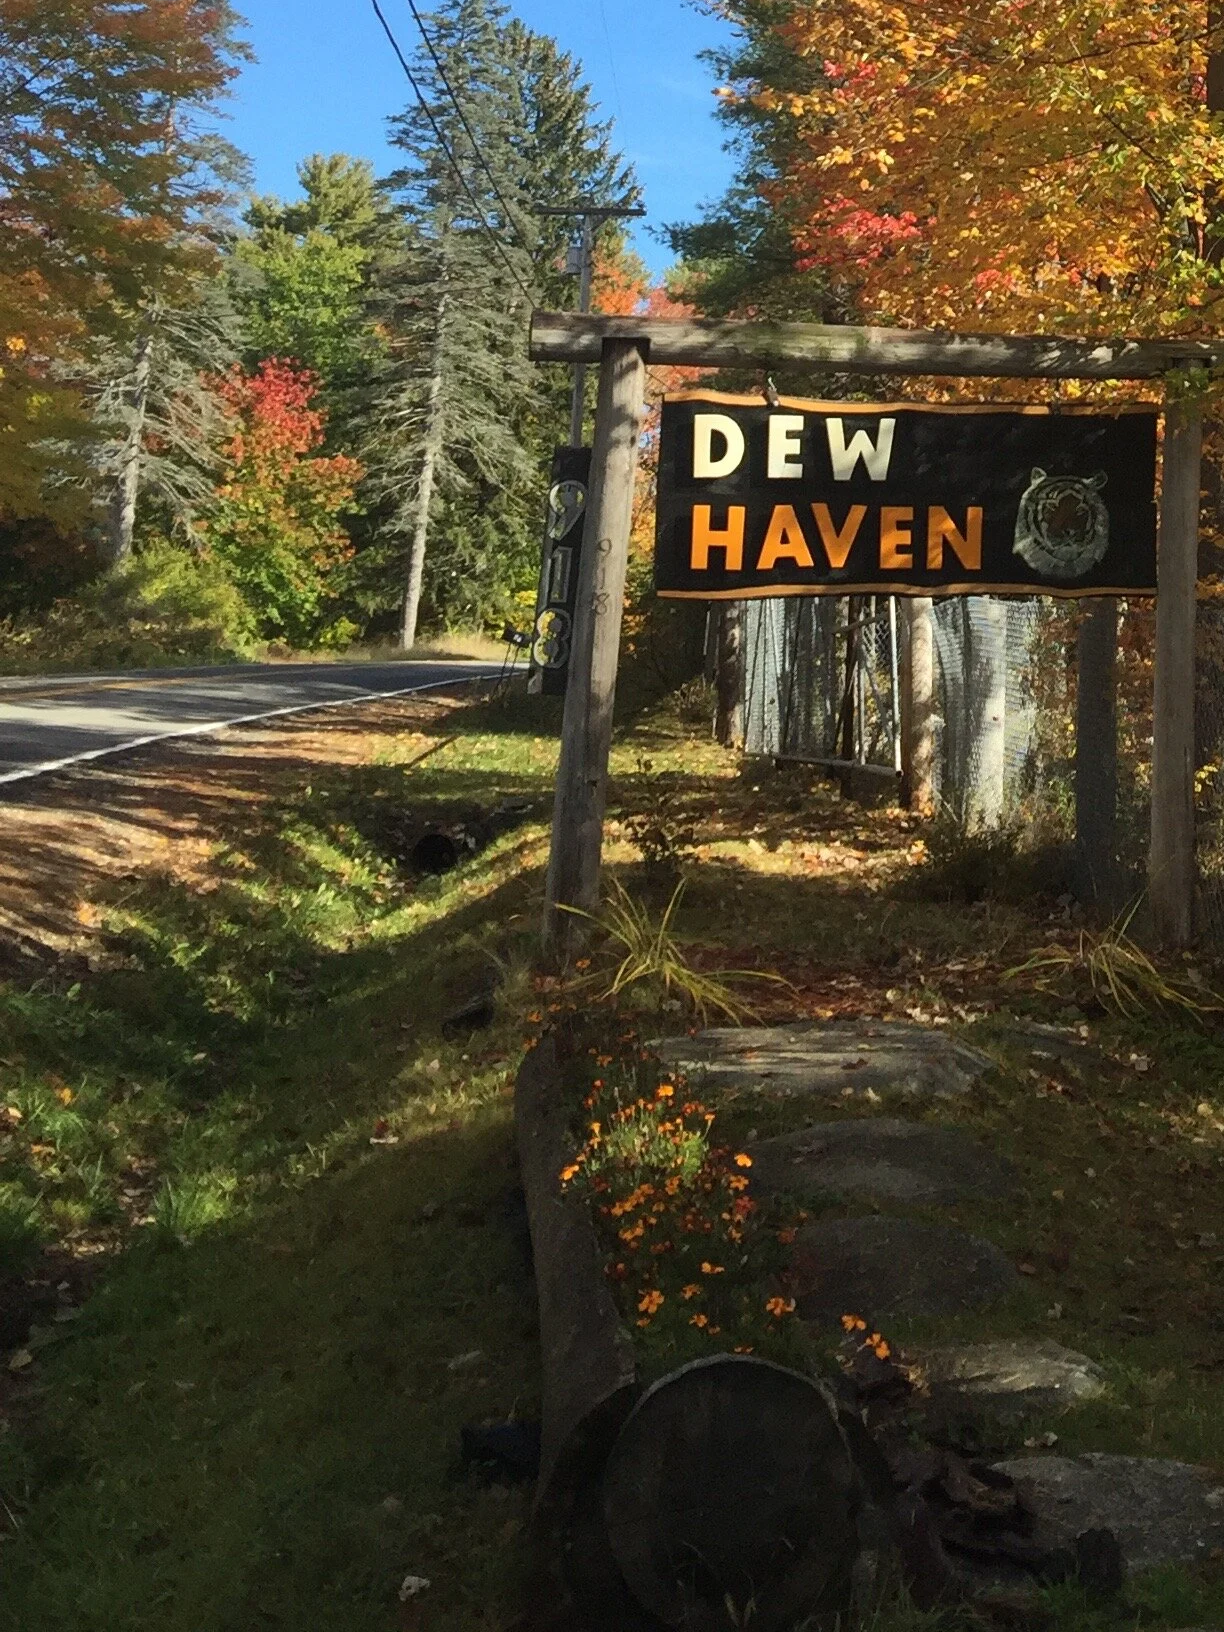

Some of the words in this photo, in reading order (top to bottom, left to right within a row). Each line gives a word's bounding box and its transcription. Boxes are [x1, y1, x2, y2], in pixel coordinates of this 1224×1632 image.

[692, 413, 896, 481] DEW
[690, 502, 983, 571] HAVEN
[532, 479, 586, 669] 918
[591, 537, 612, 616] 918
